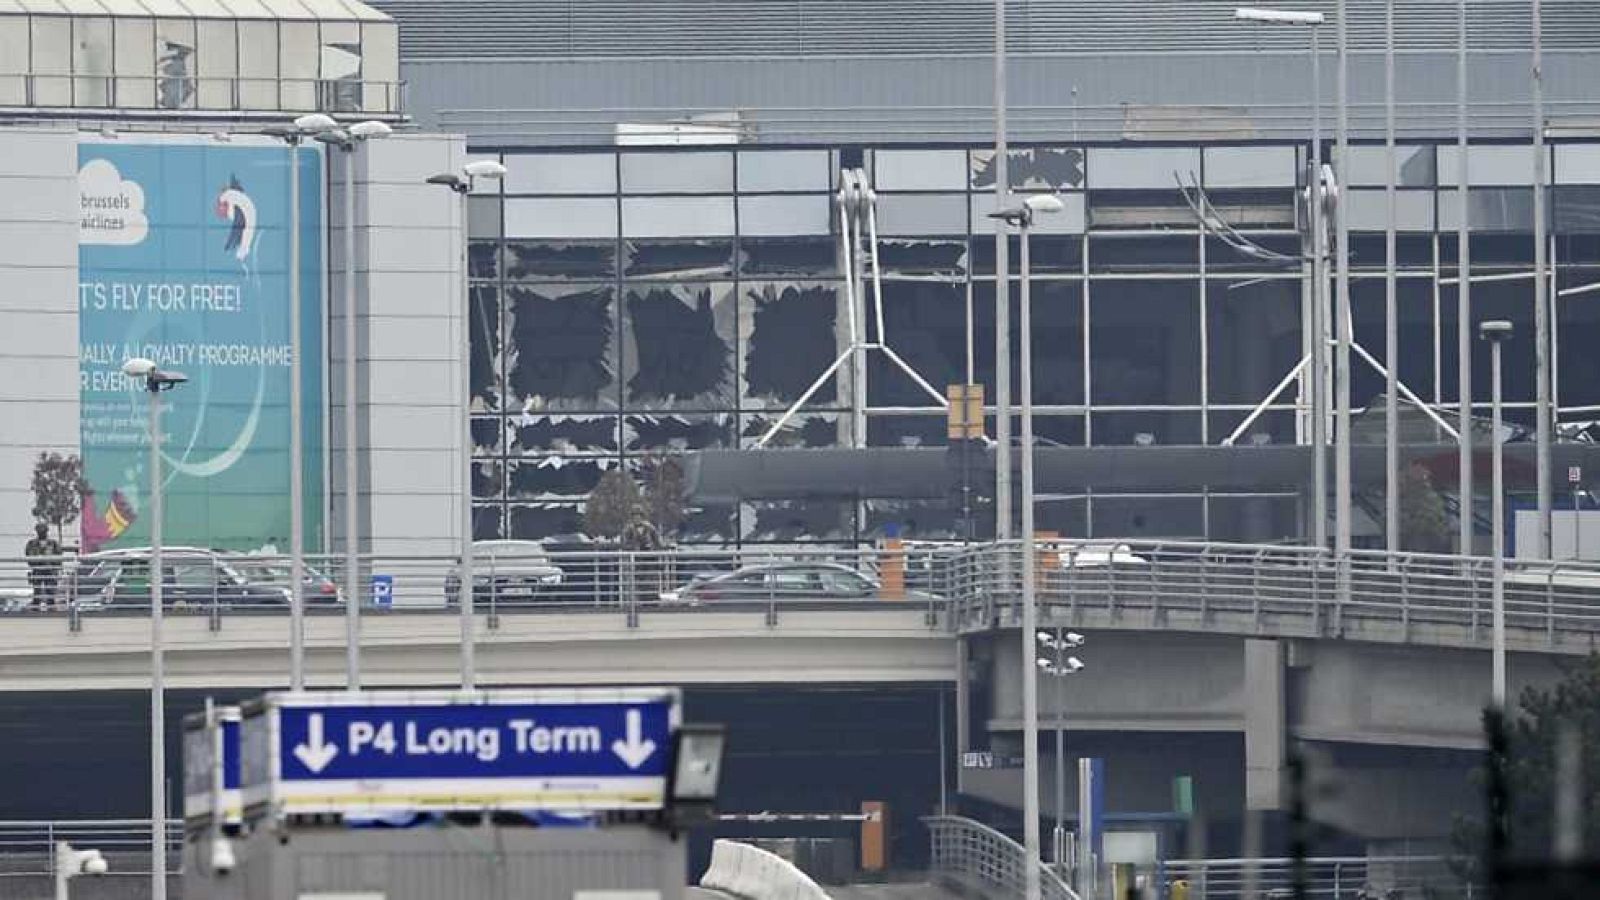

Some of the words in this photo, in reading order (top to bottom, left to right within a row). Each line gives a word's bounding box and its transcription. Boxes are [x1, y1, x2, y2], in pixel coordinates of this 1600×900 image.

[80, 192, 130, 209] brussels
[80, 213, 125, 230] airlines
[112, 284, 142, 310] FLY
[148, 284, 186, 310] FOR
[191, 284, 241, 312] FREE!
[200, 344, 292, 366] PROGRAMME
[349, 721, 397, 755] P4
[405, 721, 499, 761] Long
[508, 719, 600, 753] Term
